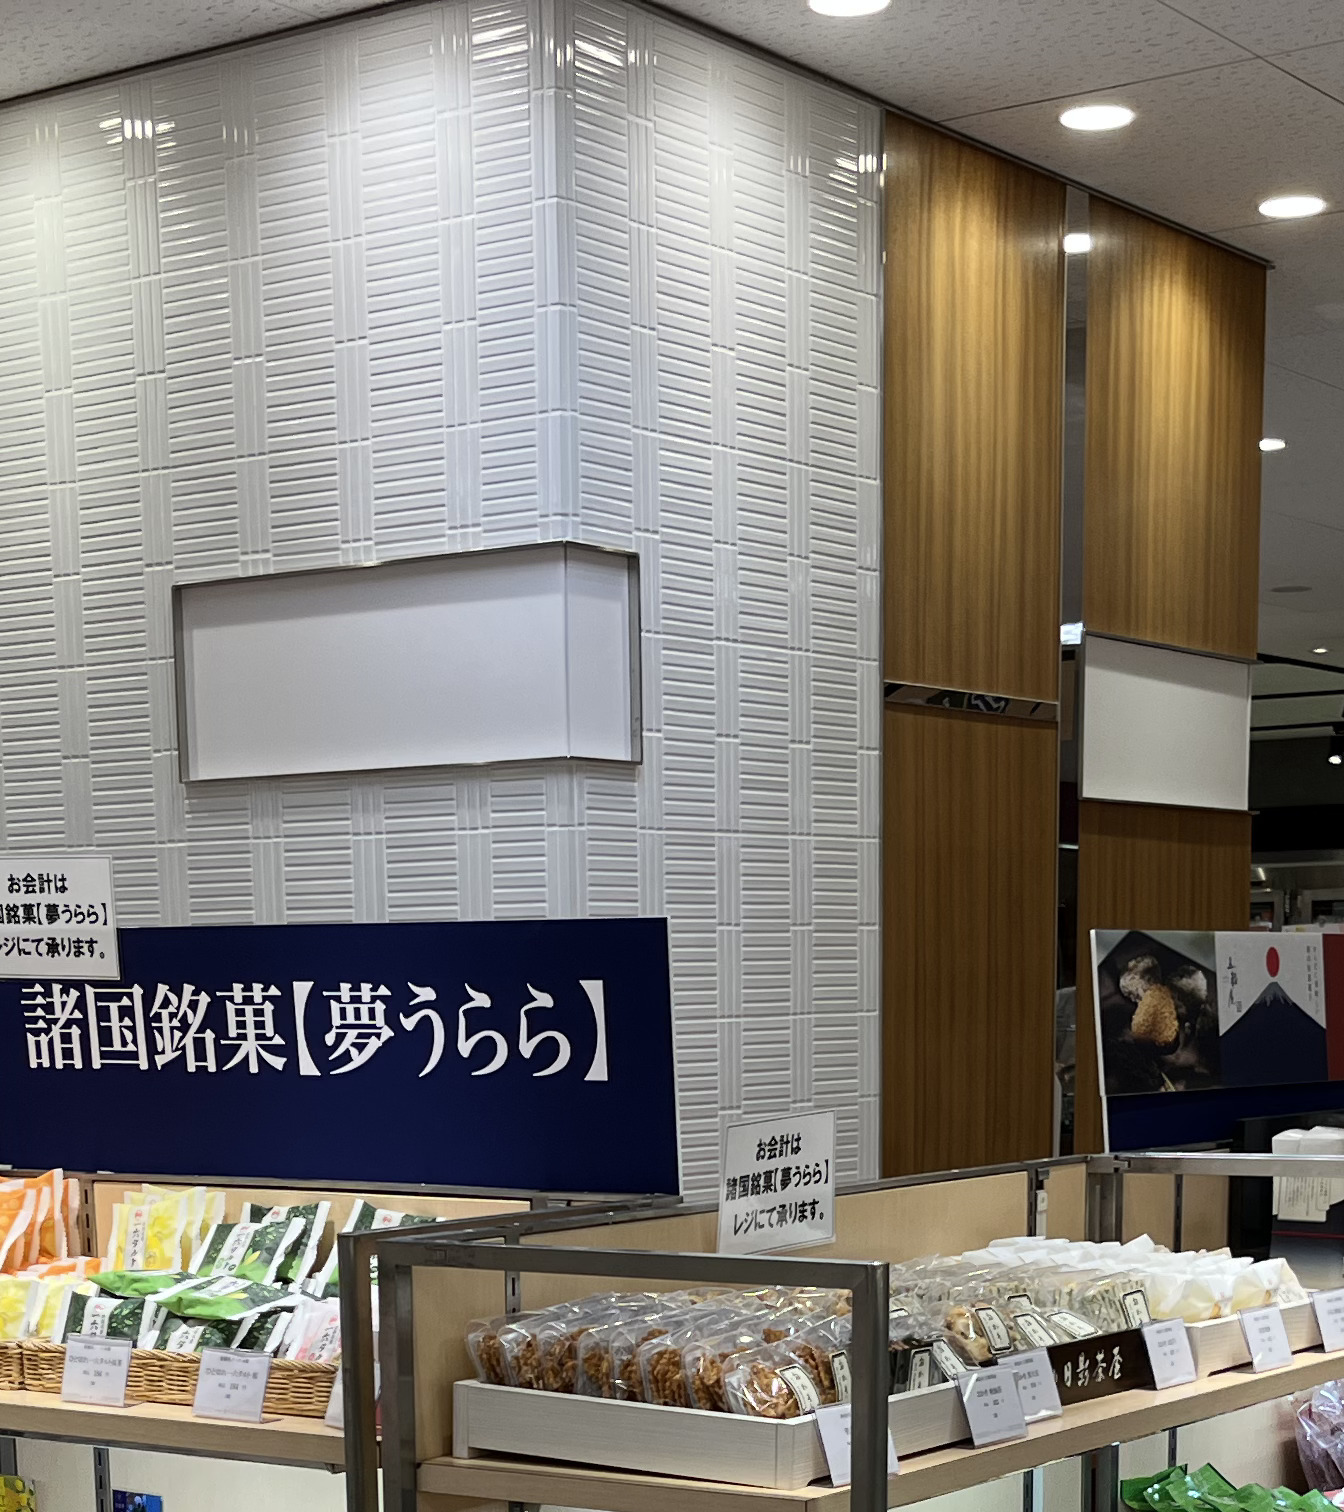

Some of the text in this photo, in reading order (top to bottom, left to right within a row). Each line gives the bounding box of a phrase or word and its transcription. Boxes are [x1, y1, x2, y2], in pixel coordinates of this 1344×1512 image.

[7, 873, 69, 894] お会計は
[20, 979, 609, 1083] 諸国銘菓【夢うらら】
[756, 1132, 802, 1161] お会計は
[725, 1159, 829, 1202] 諸国銘菓【夢うらら】
[734, 1198, 824, 1236] レジにて承ります。
